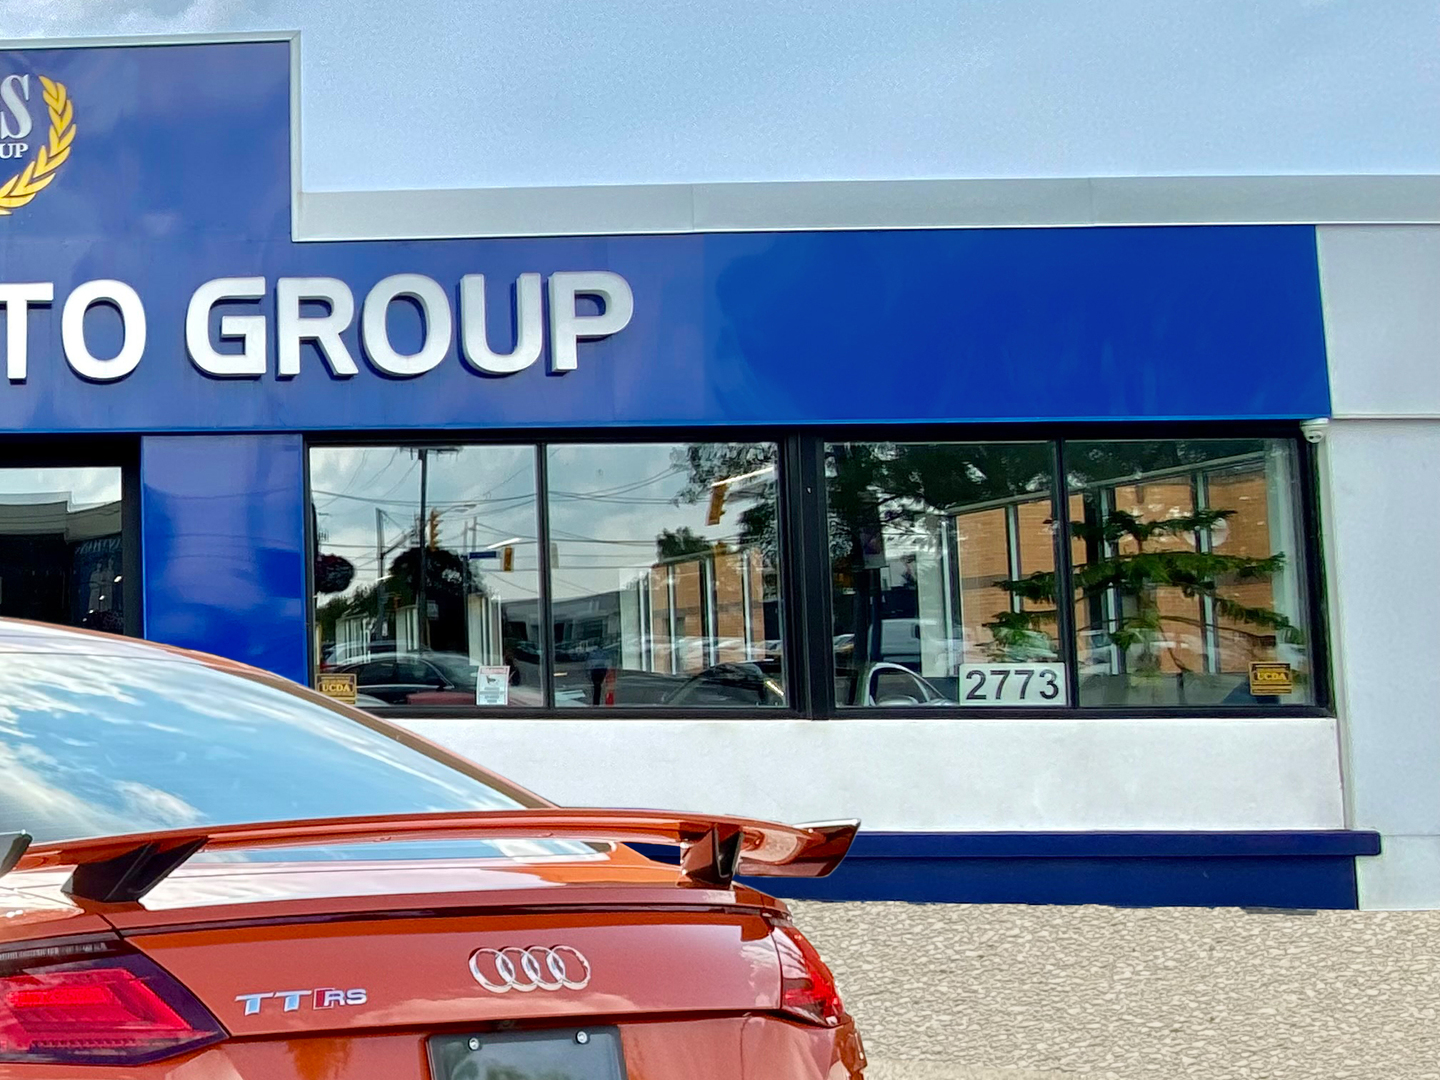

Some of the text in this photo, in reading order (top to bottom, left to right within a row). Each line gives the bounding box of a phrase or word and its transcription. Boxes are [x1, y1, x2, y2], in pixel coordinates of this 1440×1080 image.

[186, 271, 634, 378] GROUP
[322, 684, 351, 692] UCDA
[965, 669, 1059, 700] 2773
[1257, 672, 1287, 680] UCDA
[234, 987, 367, 1016] TT RS
